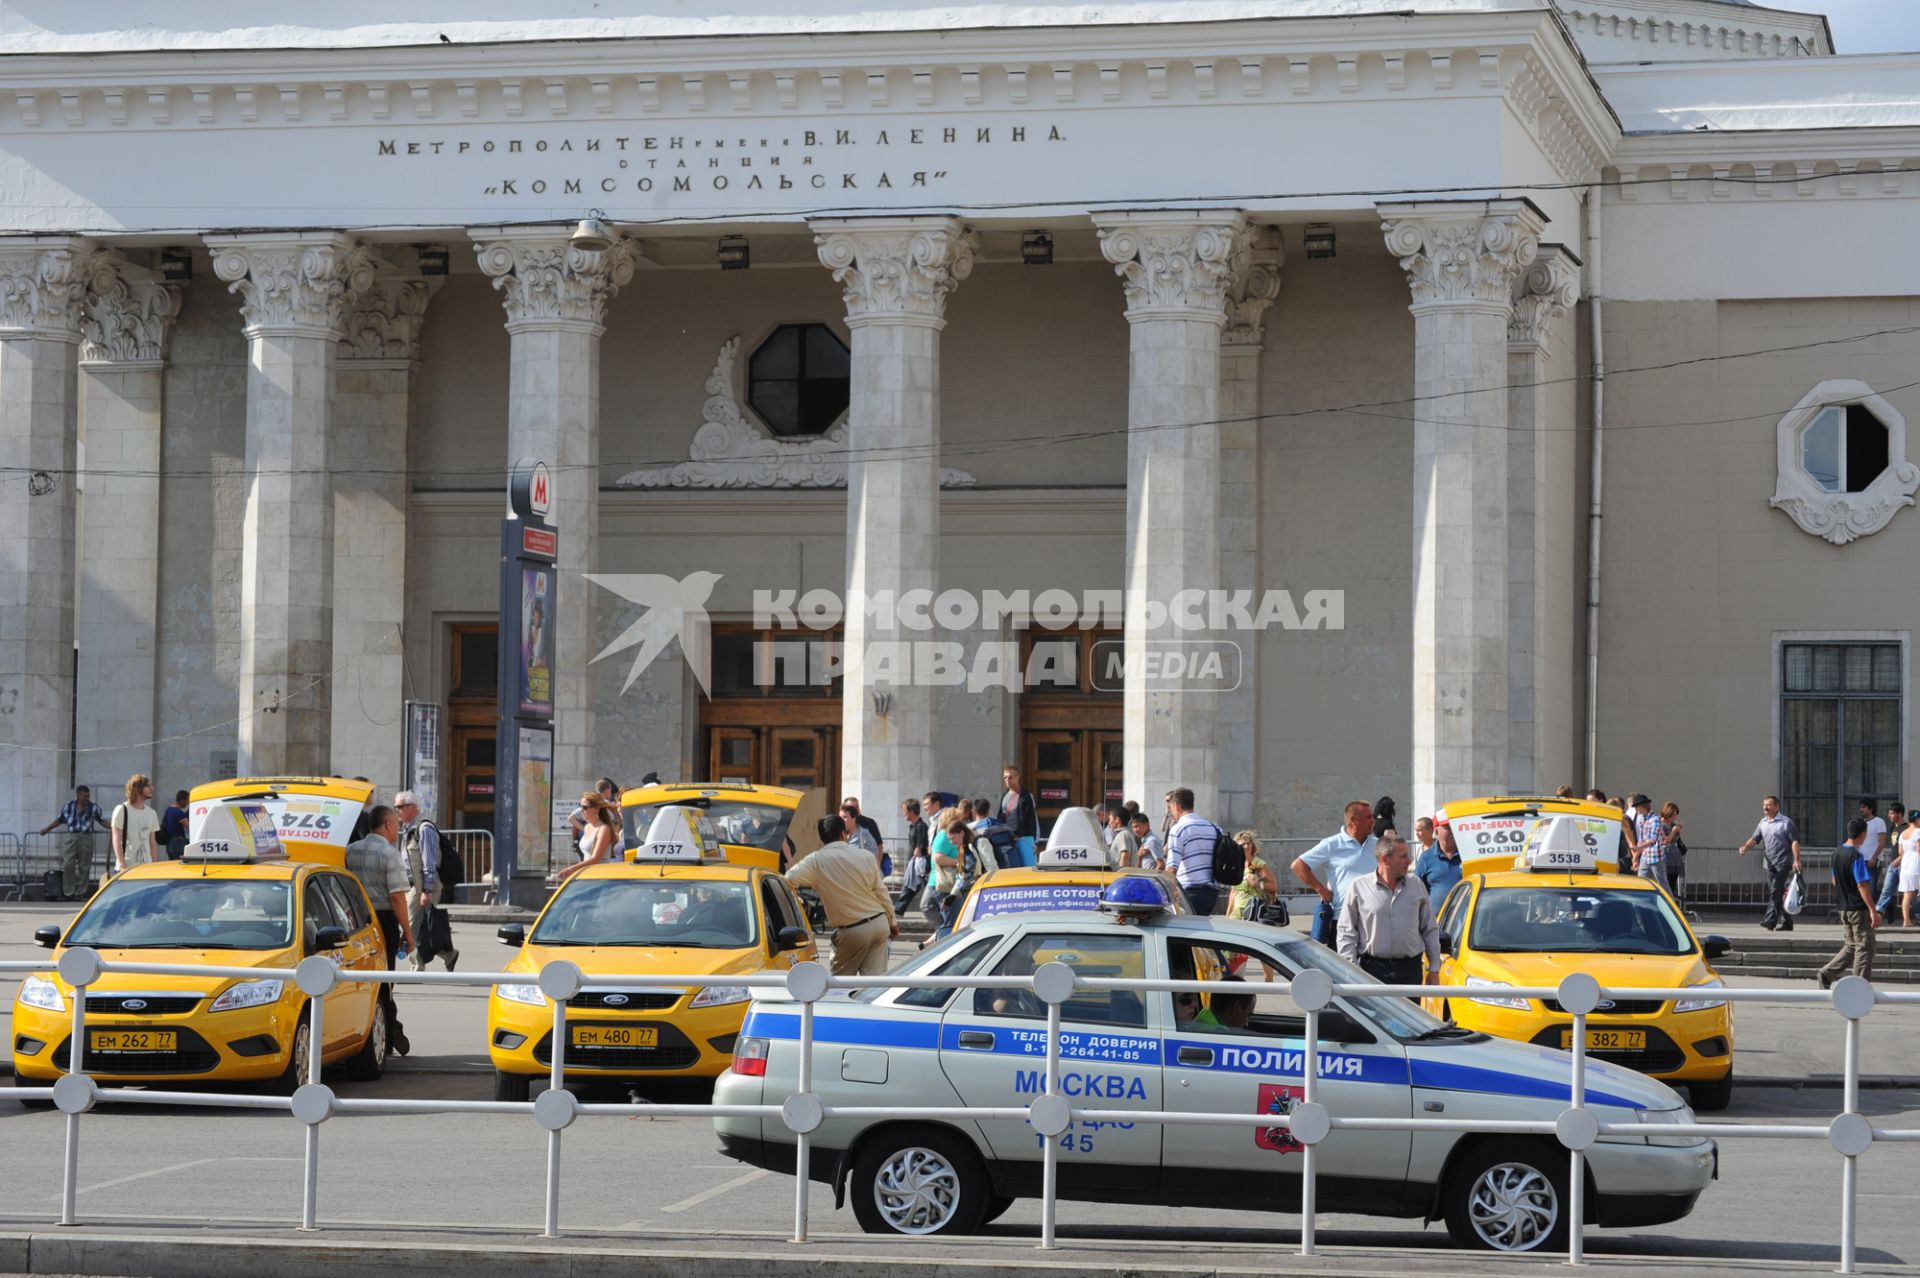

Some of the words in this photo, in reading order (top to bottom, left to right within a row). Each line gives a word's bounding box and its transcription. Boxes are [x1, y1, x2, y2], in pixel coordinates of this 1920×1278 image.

[378, 136, 684, 156] МЕТРОПОЛИТЕН
[620, 156, 813, 169] СТАНЦИЯ
[1458, 819, 1525, 832] AMF.RU
[278, 829, 330, 839] ДОСТАВ
[200, 843, 230, 853] 1514
[653, 844, 683, 854] 1737
[1056, 849, 1088, 860] 1654
[1549, 853, 1581, 864] 3538
[983, 889, 1049, 903] УСИЛЕНИЕ
[122, 1034, 149, 1048] 262
[158, 1033, 172, 1044] 77
[604, 1030, 631, 1044] 480
[640, 1029, 653, 1041] 77
[1012, 1031, 1080, 1045] ТЕЛЕОН
[1088, 1036, 1158, 1051] ДОВЕРИЯ
[1592, 1033, 1619, 1047] 382
[1628, 1032, 1642, 1043] 77
